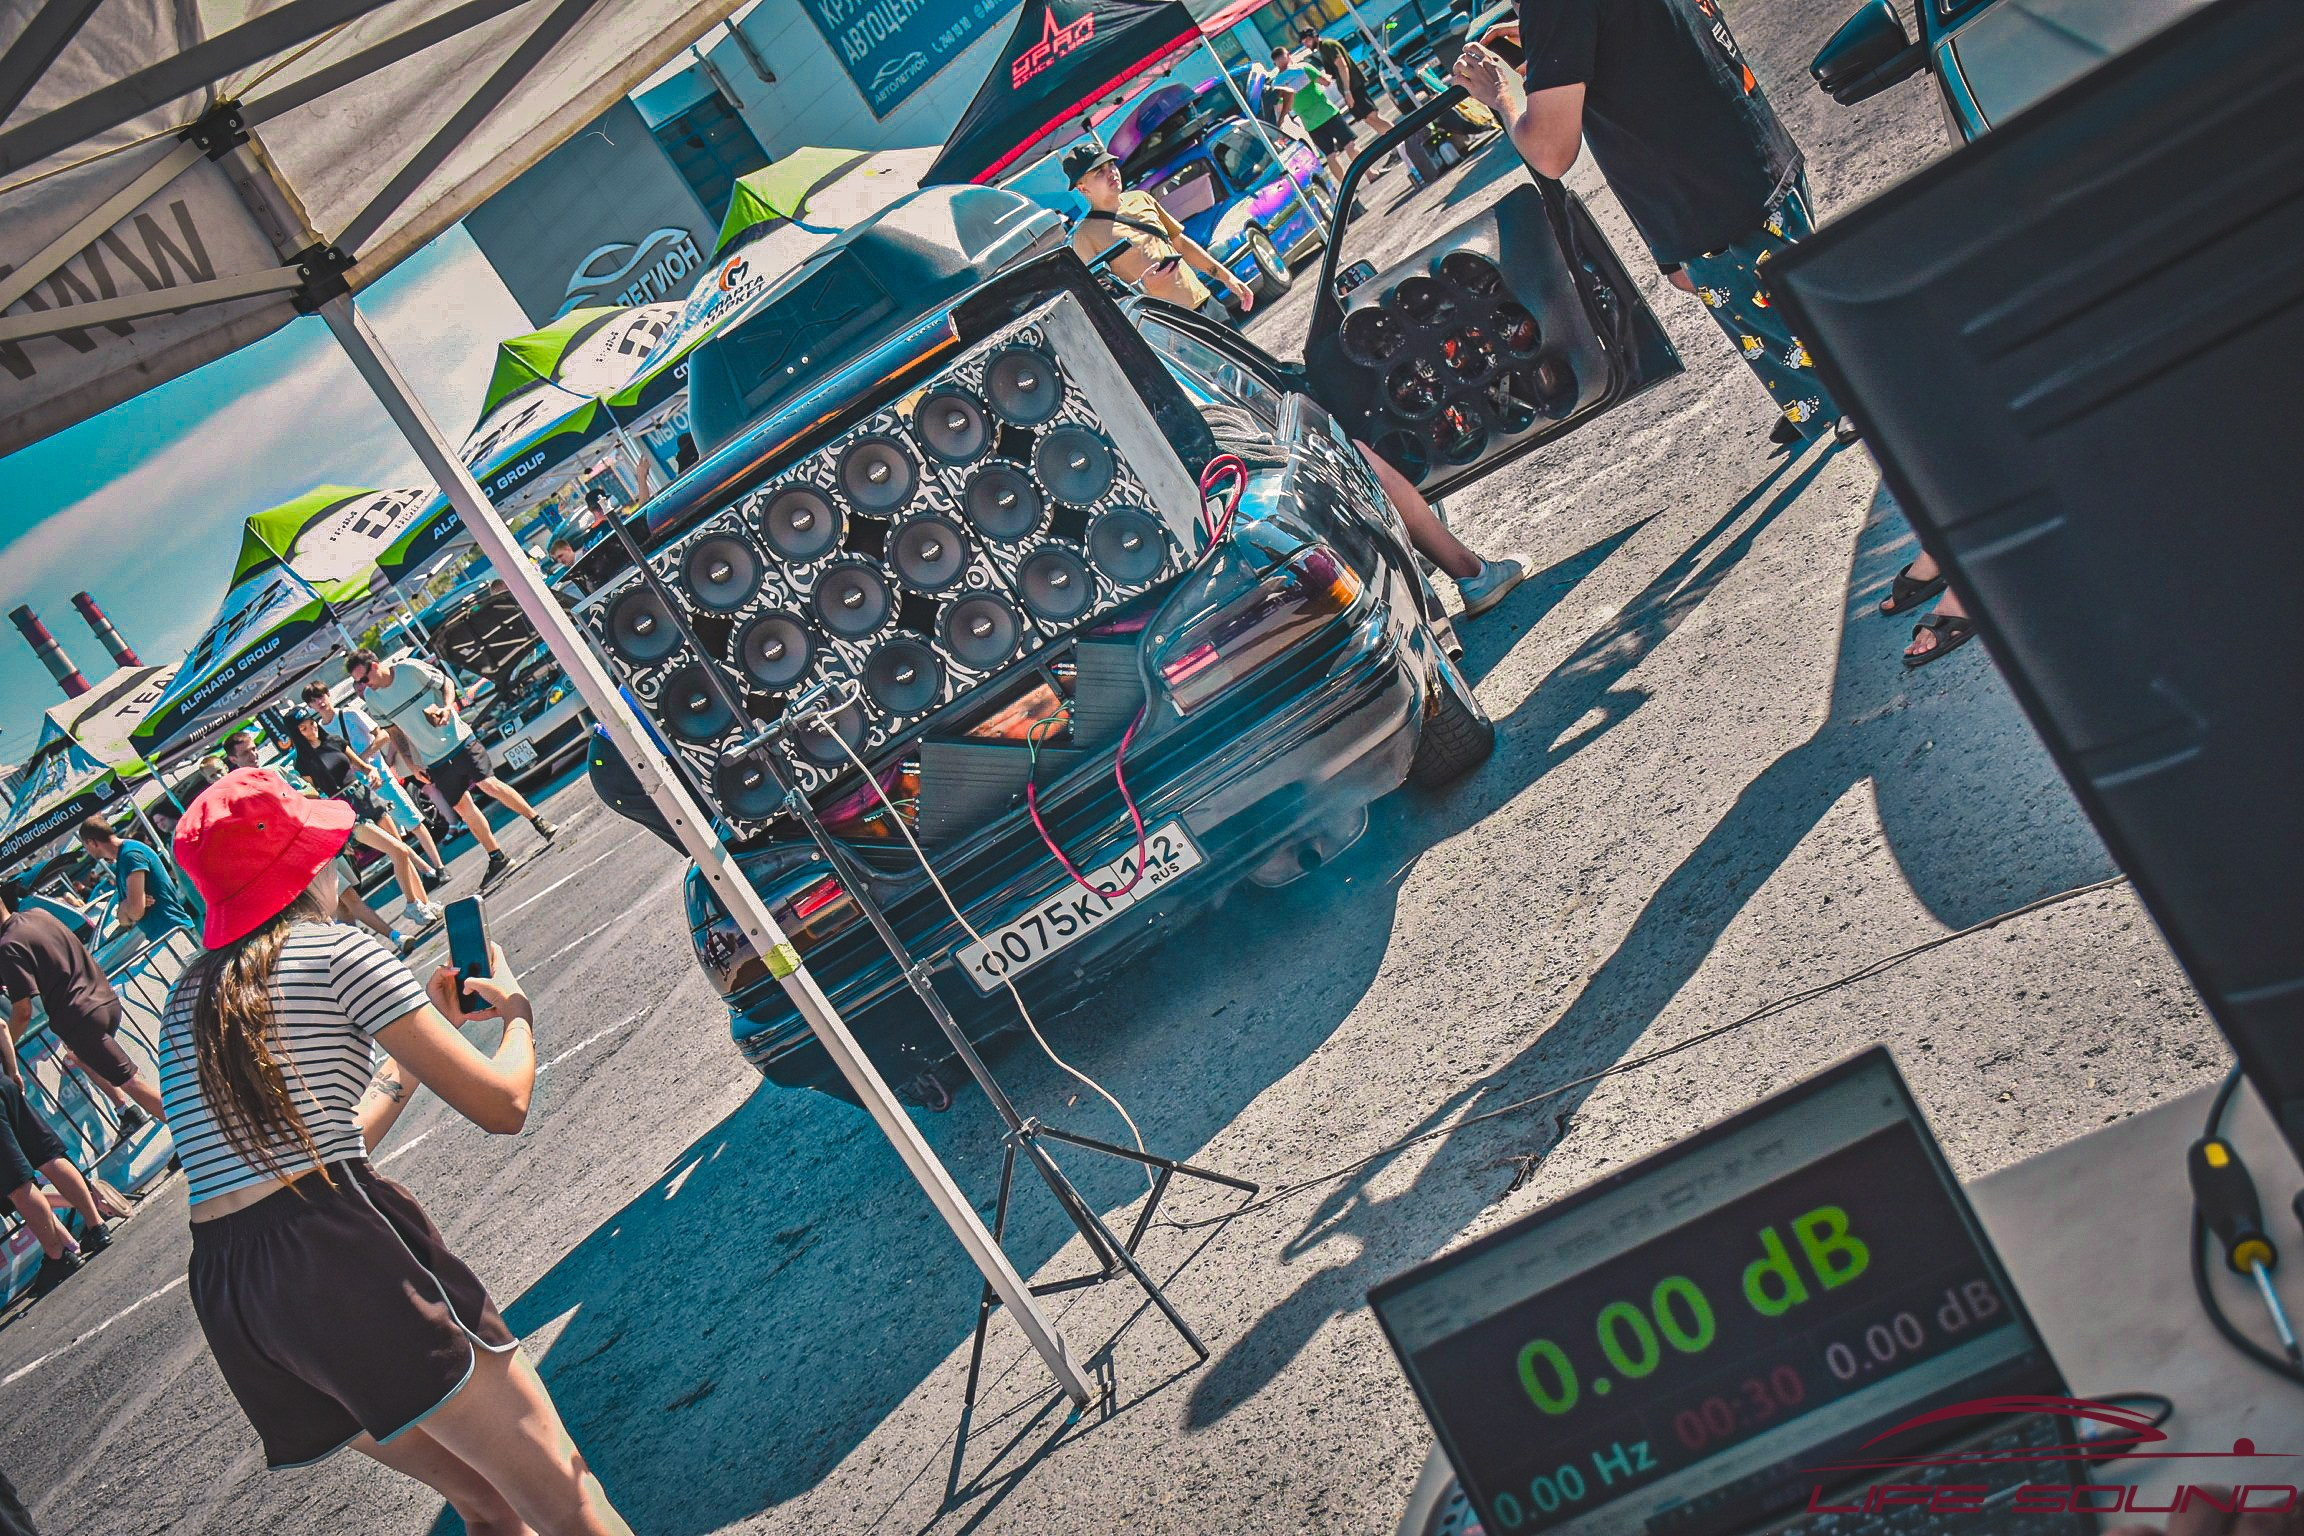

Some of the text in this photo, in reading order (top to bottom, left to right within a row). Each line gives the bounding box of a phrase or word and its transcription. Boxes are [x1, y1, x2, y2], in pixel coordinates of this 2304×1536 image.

[841, 0, 925, 66] АВТОЦЕН
[616, 233, 702, 307] ЛЕГИОН
[496, 451, 546, 489] GROUP
[180, 668, 236, 715] ALPHARD
[238, 637, 281, 671] GROUP
[0, 802, 84, 860] .alphardaudio.ru
[1149, 862, 1180, 884] RUS
[1515, 1205, 1871, 1416] 0.00 dB
[1495, 1279, 2000, 1528] 0.00 Hz 00:30 0.00 dB
